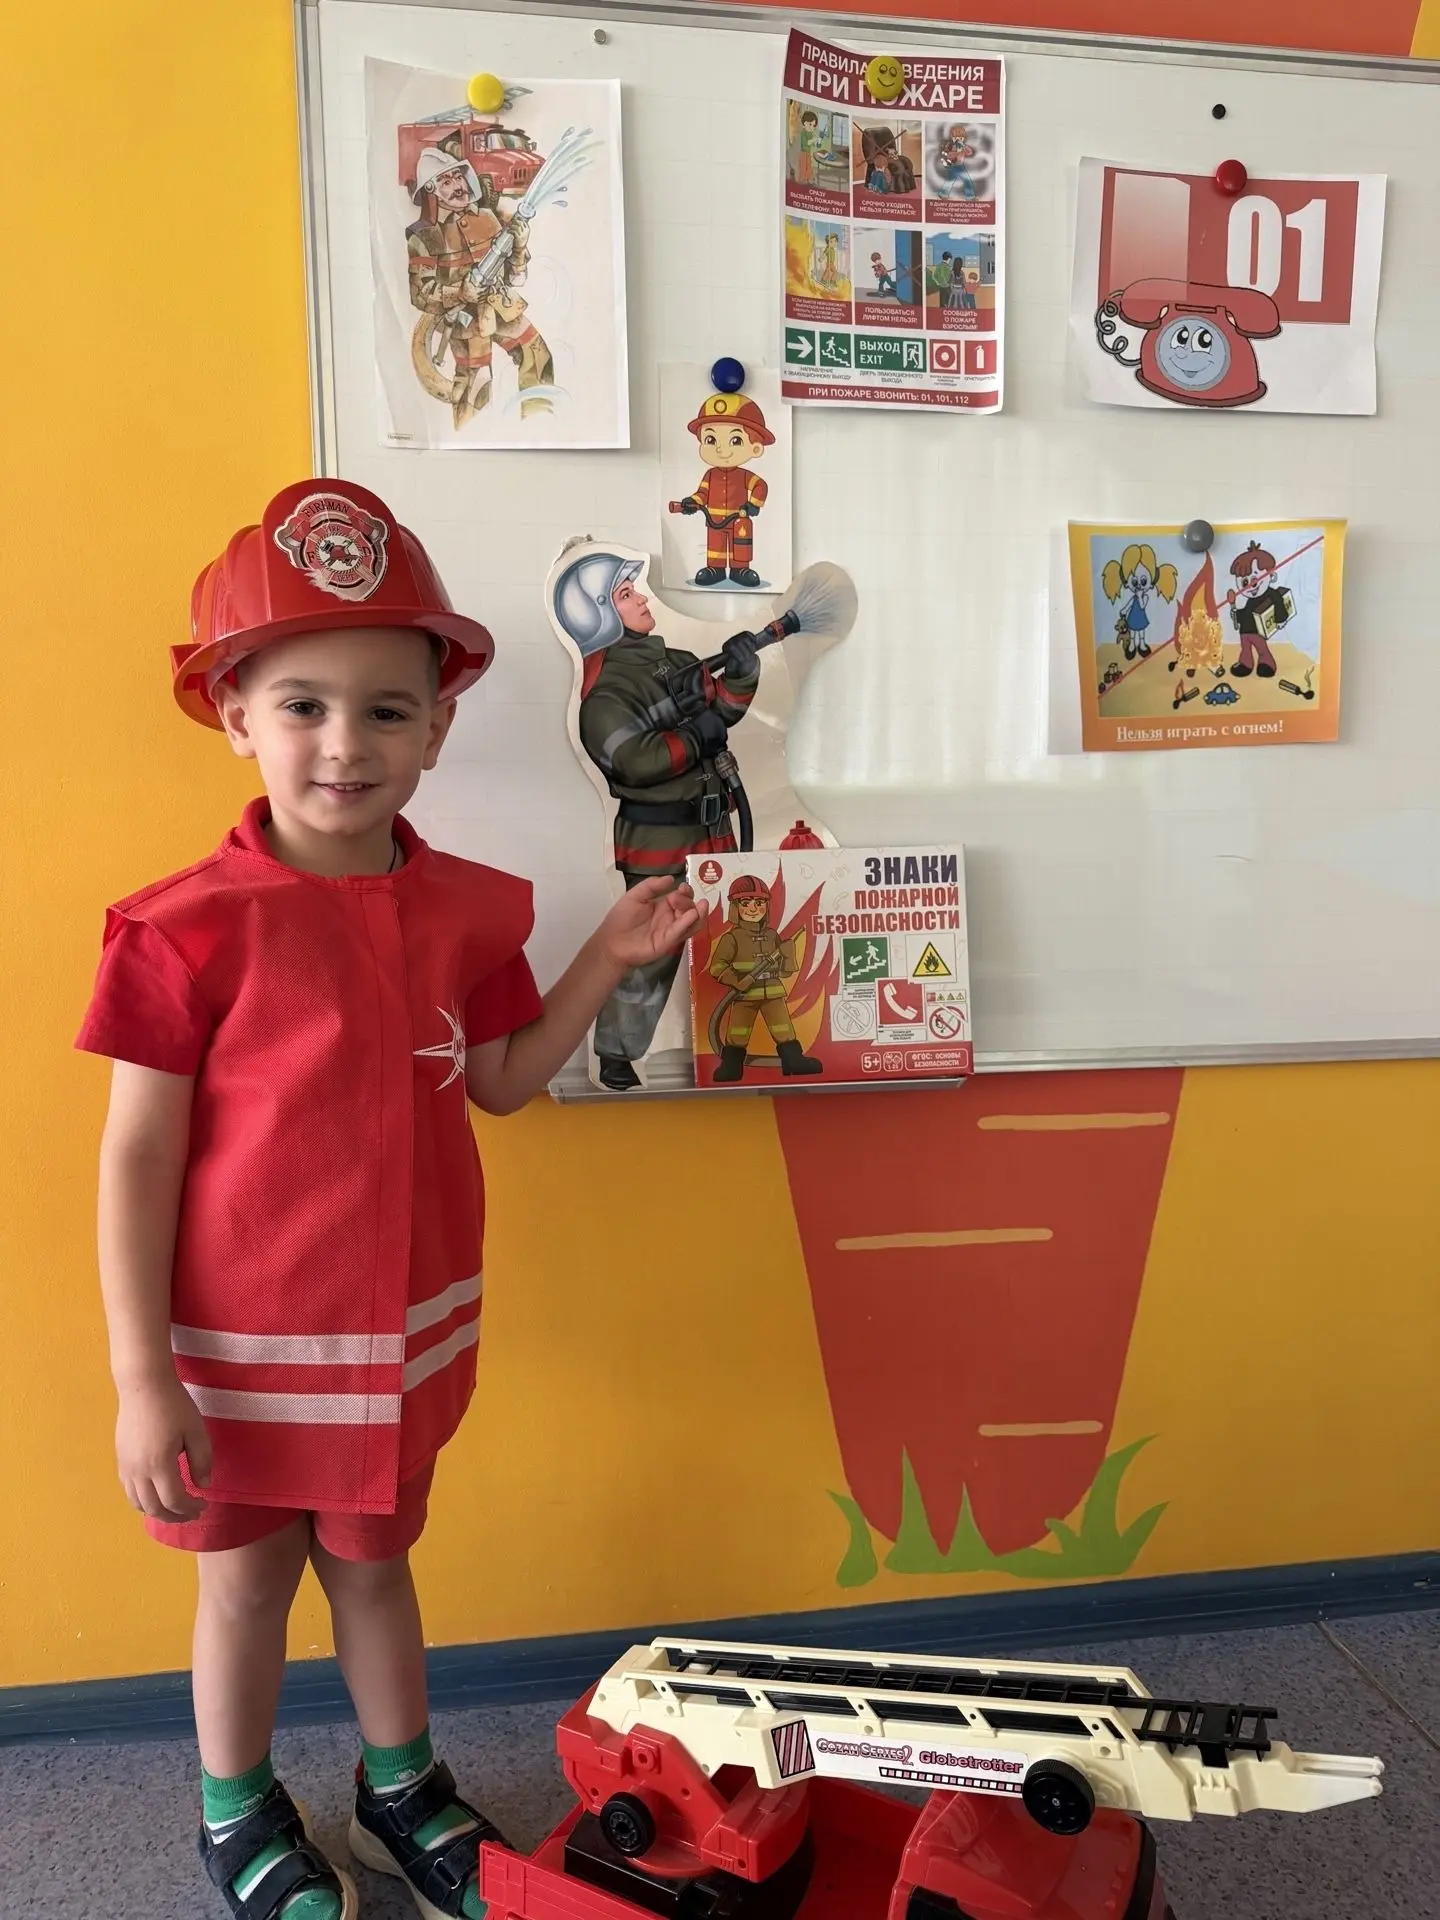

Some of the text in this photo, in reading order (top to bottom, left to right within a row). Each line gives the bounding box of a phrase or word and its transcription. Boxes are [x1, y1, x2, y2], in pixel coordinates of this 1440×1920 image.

[802, 42, 984, 82] ПРАВИЛА ВЕДЕНИЯ
[799, 63, 984, 110] ПРИ ПЖАРЕ
[832, 207, 843, 215] 101
[1226, 194, 1327, 302] 01
[862, 314, 890, 322] ЛИФТОМ
[864, 307, 915, 316] ПОЛЬЗОВАТЬСЯ
[859, 340, 901, 355] ВЫХОД
[859, 354, 884, 365] EXIT
[808, 387, 969, 404] ПРИ ПОЖАРЕ ЗВОНИТЬ: 01, 101, 112
[1116, 719, 1284, 742] Нельзя играть с огнем!
[864, 855, 958, 886] ЗНАКИ
[854, 883, 959, 910] ПОЖАРНОЙ
[813, 910, 960, 935] БЕЗОПАСНОСТИ
[863, 1056, 880, 1069] 5+
[912, 1053, 933, 1061] ФГОС:
[919, 1750, 1023, 1774] Globetrotter
